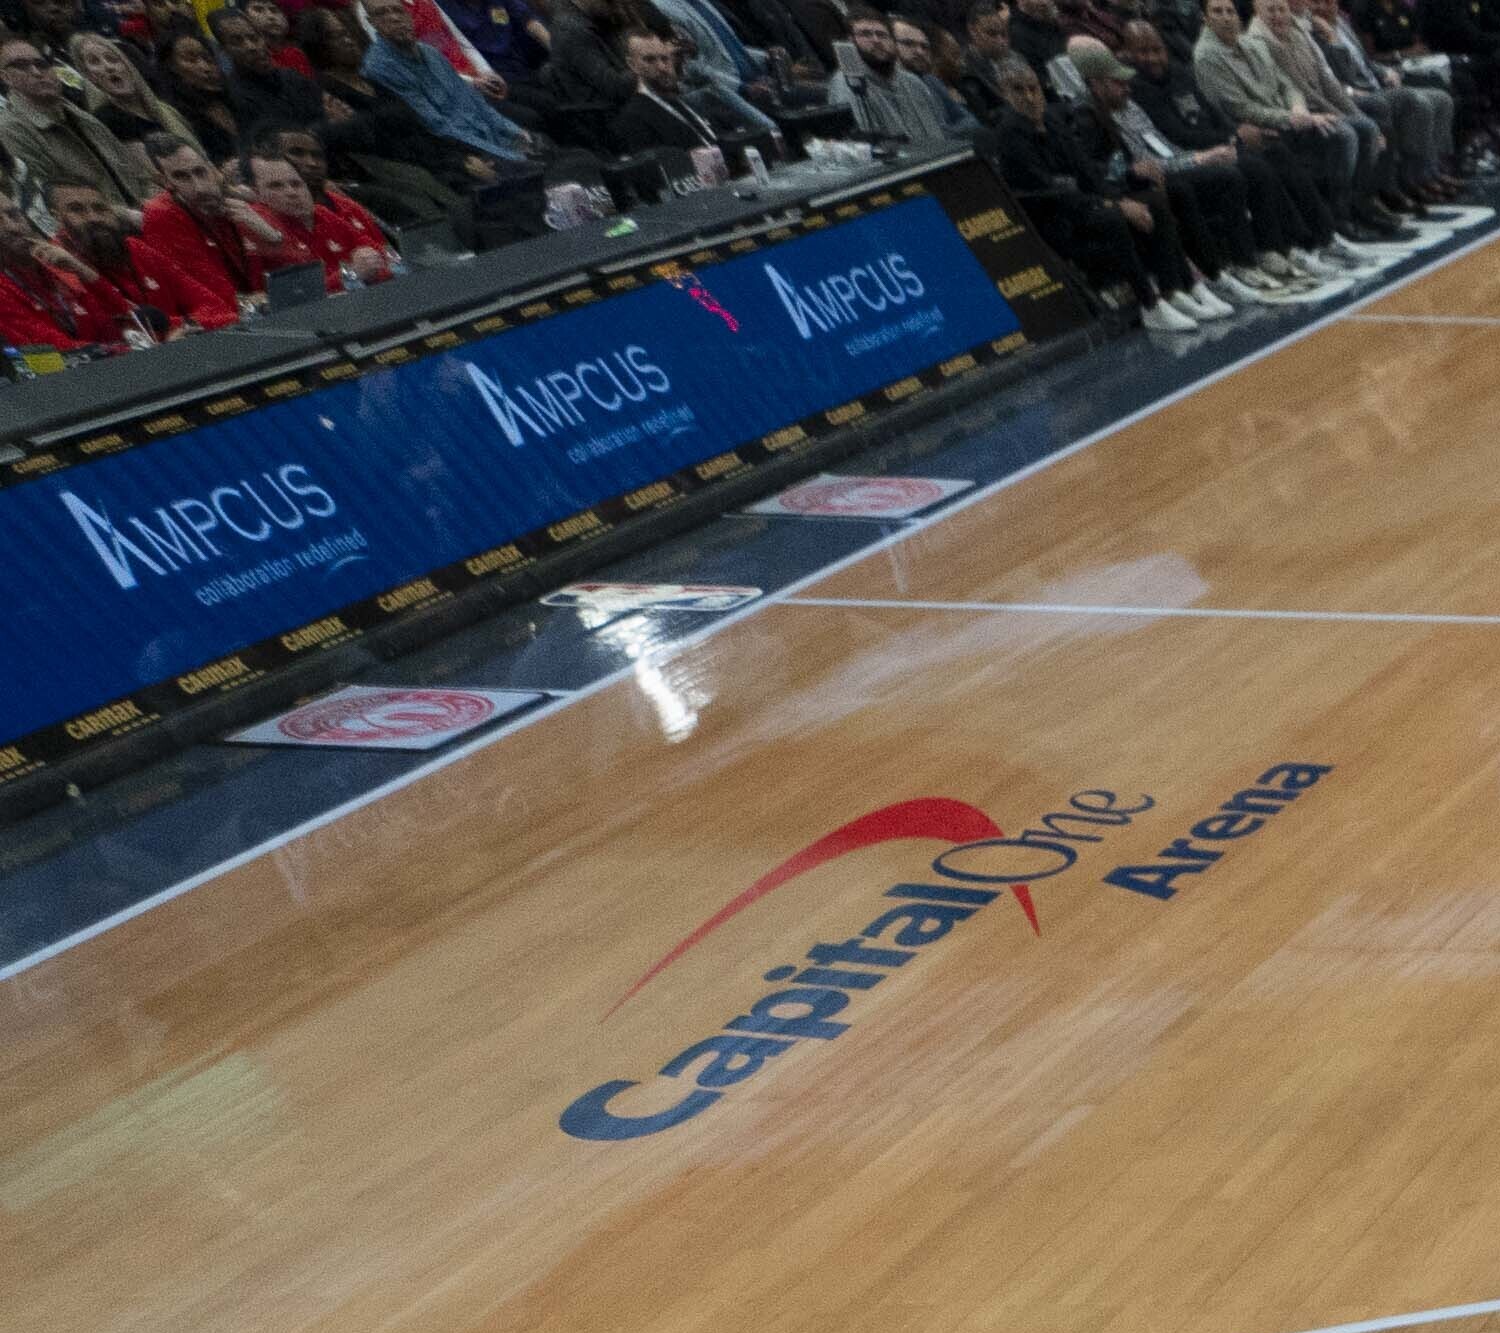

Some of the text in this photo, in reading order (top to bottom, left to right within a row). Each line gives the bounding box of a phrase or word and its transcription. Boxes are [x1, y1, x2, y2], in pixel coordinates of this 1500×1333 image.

[762, 252, 926, 340] AMPCUS
[464, 344, 672, 448] AMPCUS
[58, 463, 337, 590] AMPCUS
[193, 527, 370, 606] collaboration redefined
[1102, 761, 1338, 901] Arena
